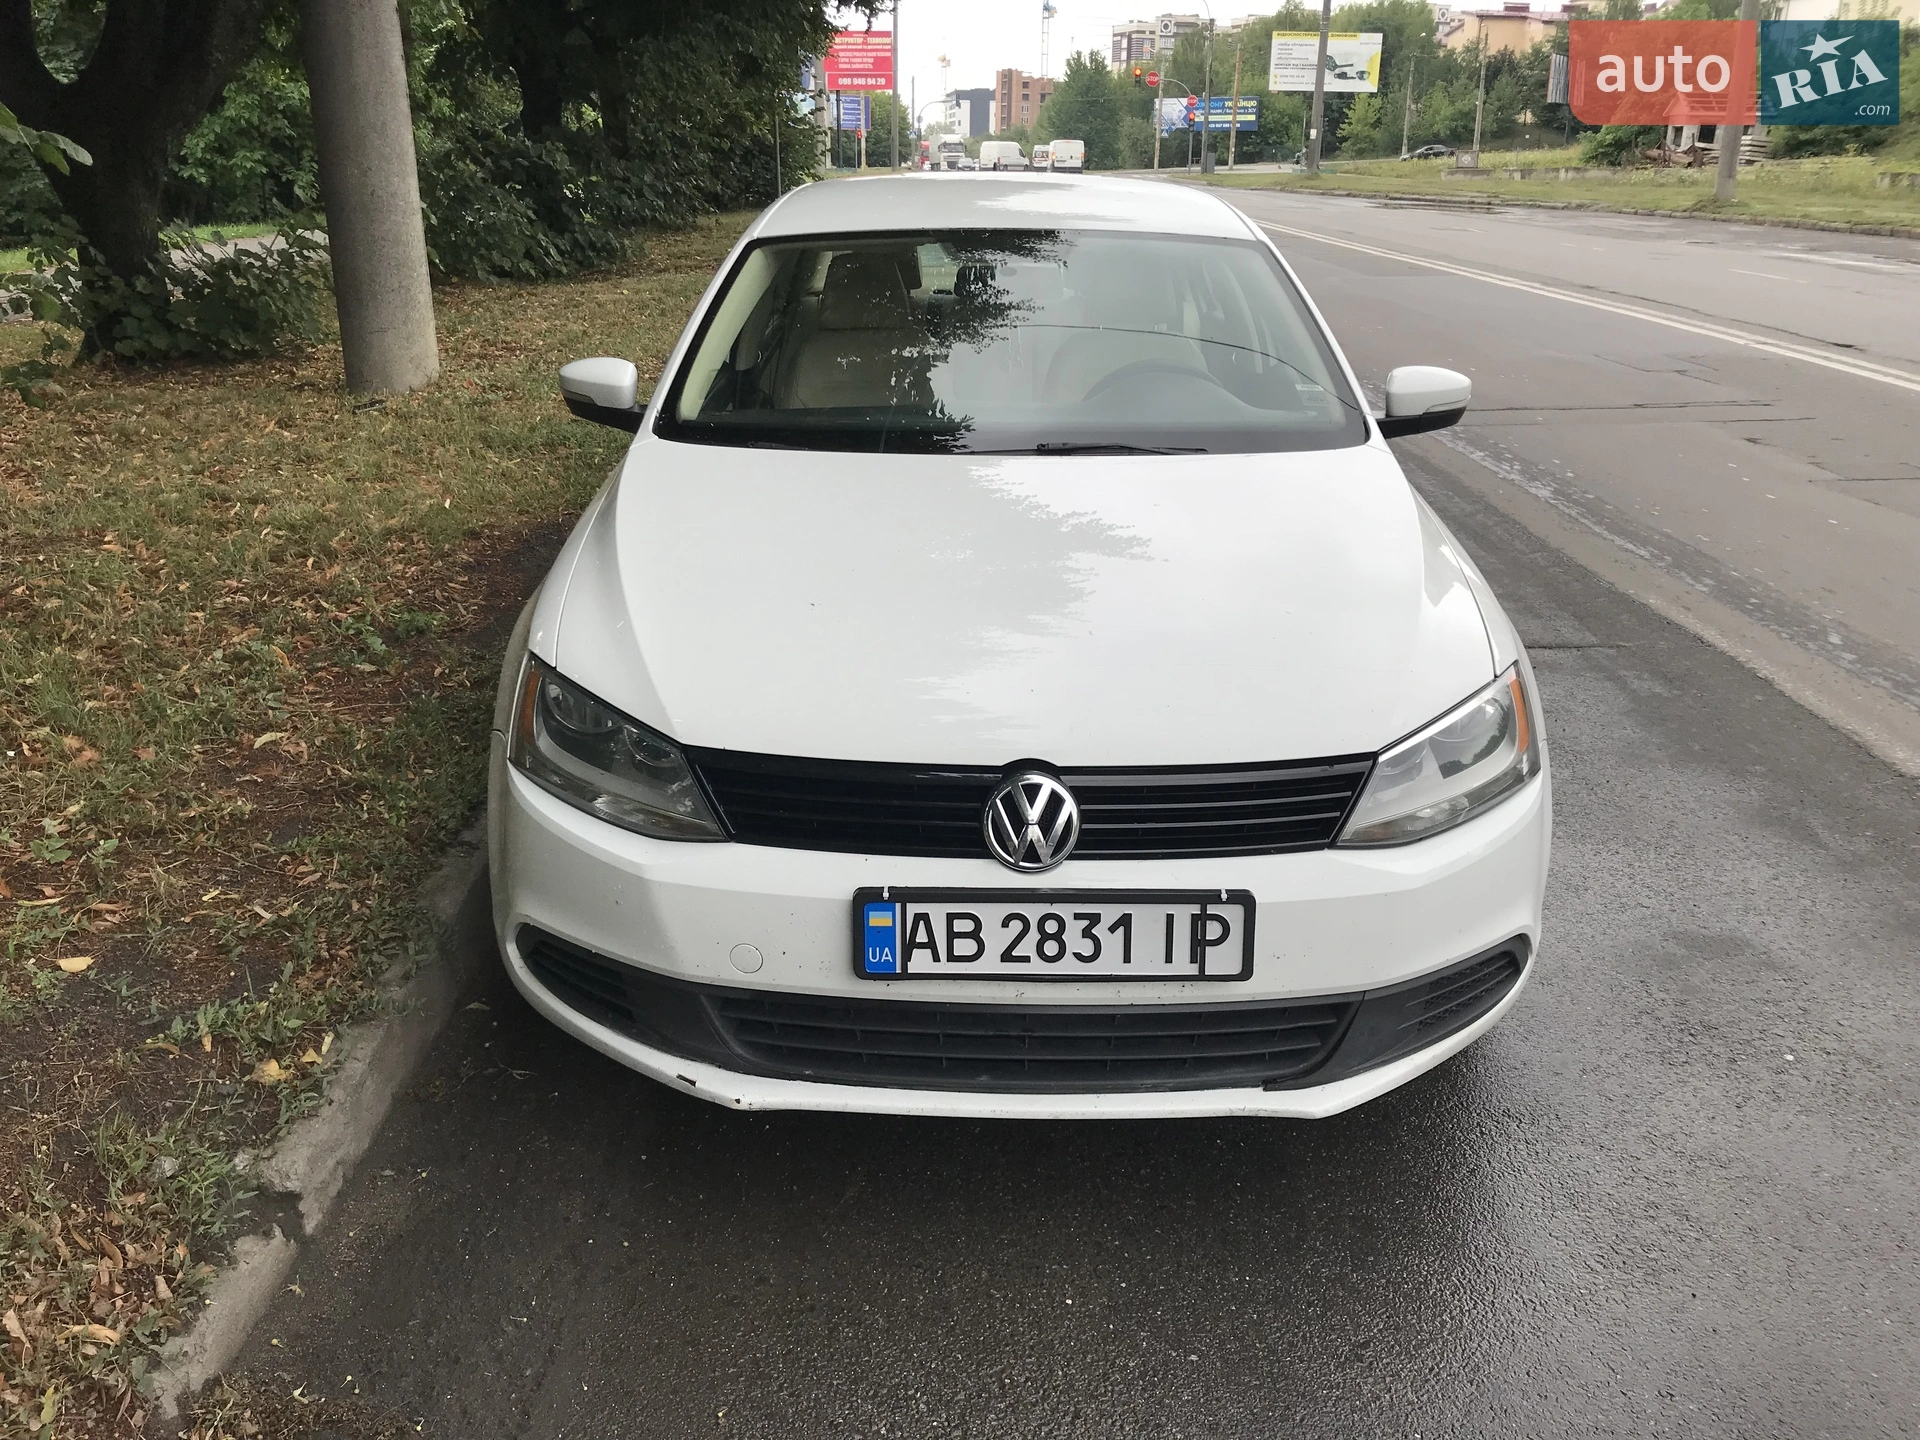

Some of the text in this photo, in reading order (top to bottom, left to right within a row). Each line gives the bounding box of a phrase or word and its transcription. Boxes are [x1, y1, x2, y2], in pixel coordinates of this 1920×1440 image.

[868, 946, 893, 963] UA
[907, 912, 1231, 964] AB 2831 IP
